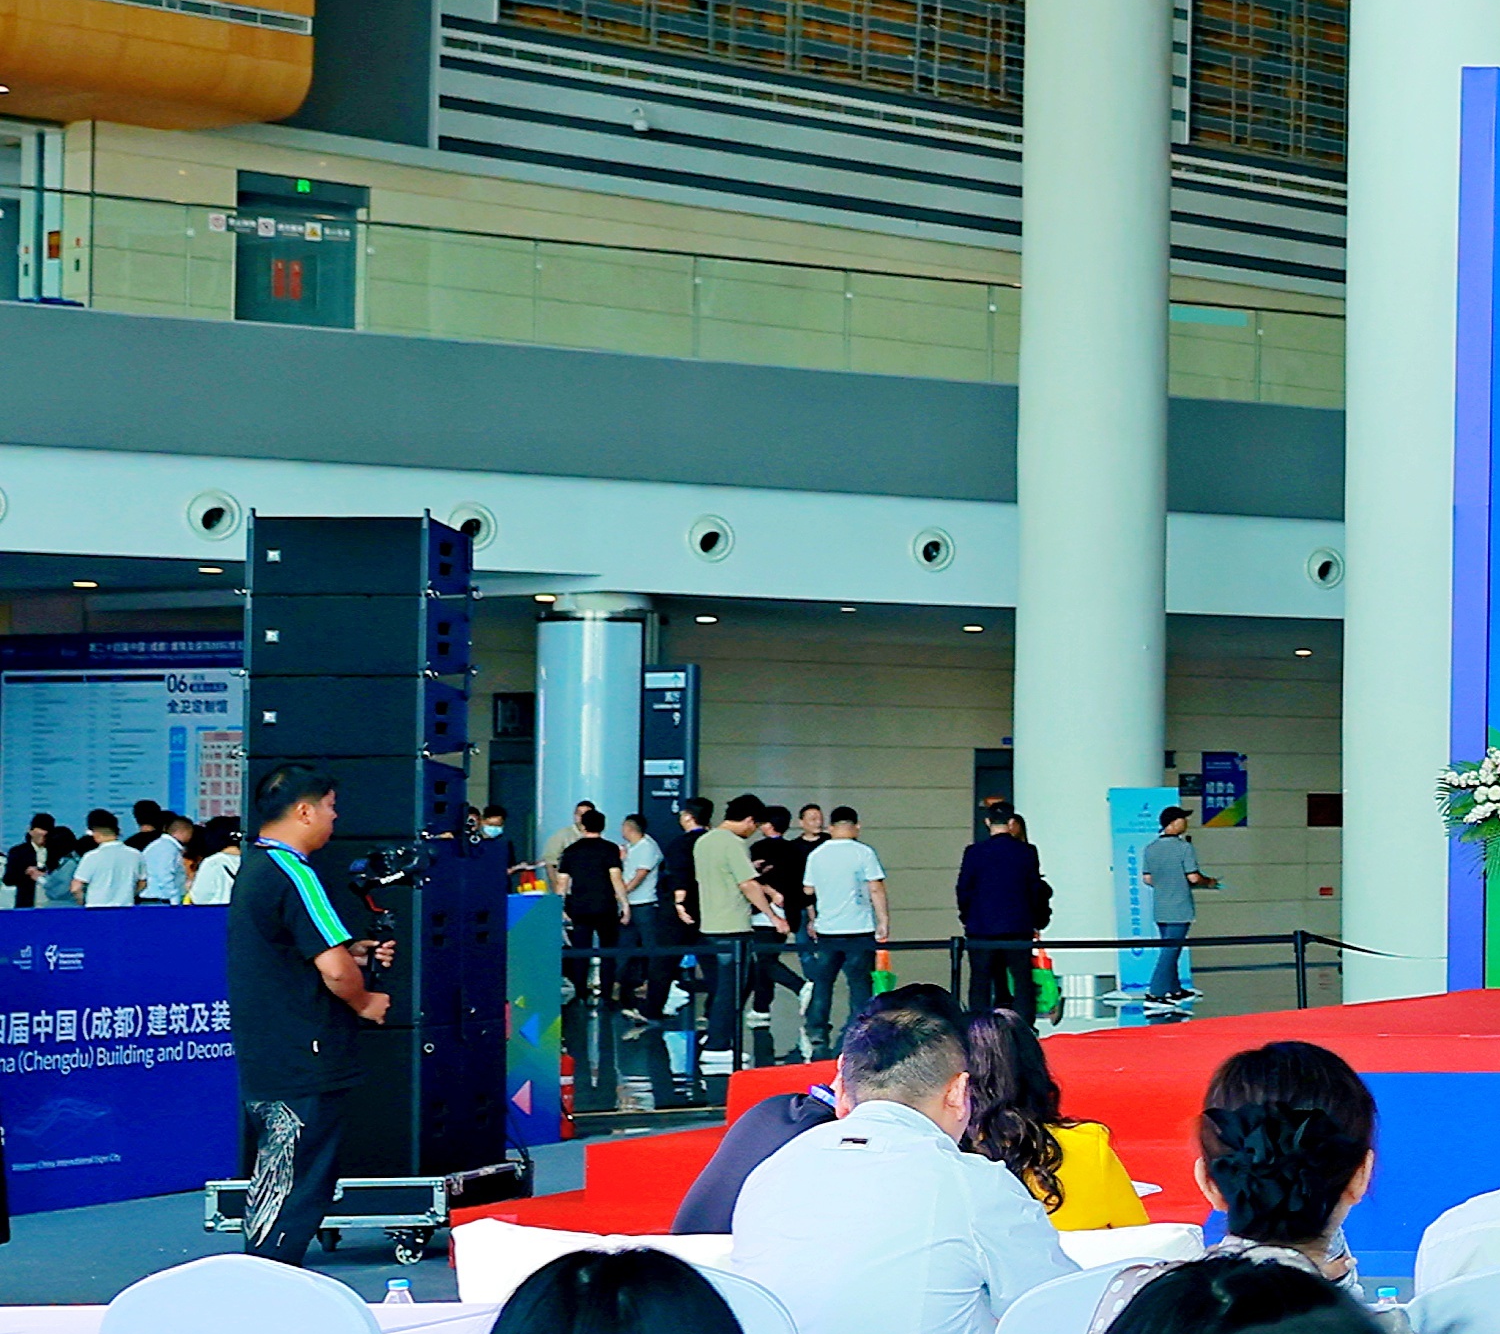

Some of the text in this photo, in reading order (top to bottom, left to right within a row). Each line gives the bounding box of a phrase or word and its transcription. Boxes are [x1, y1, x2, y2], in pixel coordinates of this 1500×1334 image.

[0, 1000, 231, 1045] 届中国（成都）建筑及装
[18, 1046, 94, 1074] (Chengdu)
[97, 1043, 154, 1069] Building
[158, 1041, 184, 1063] and
[187, 1039, 236, 1060] Decora
